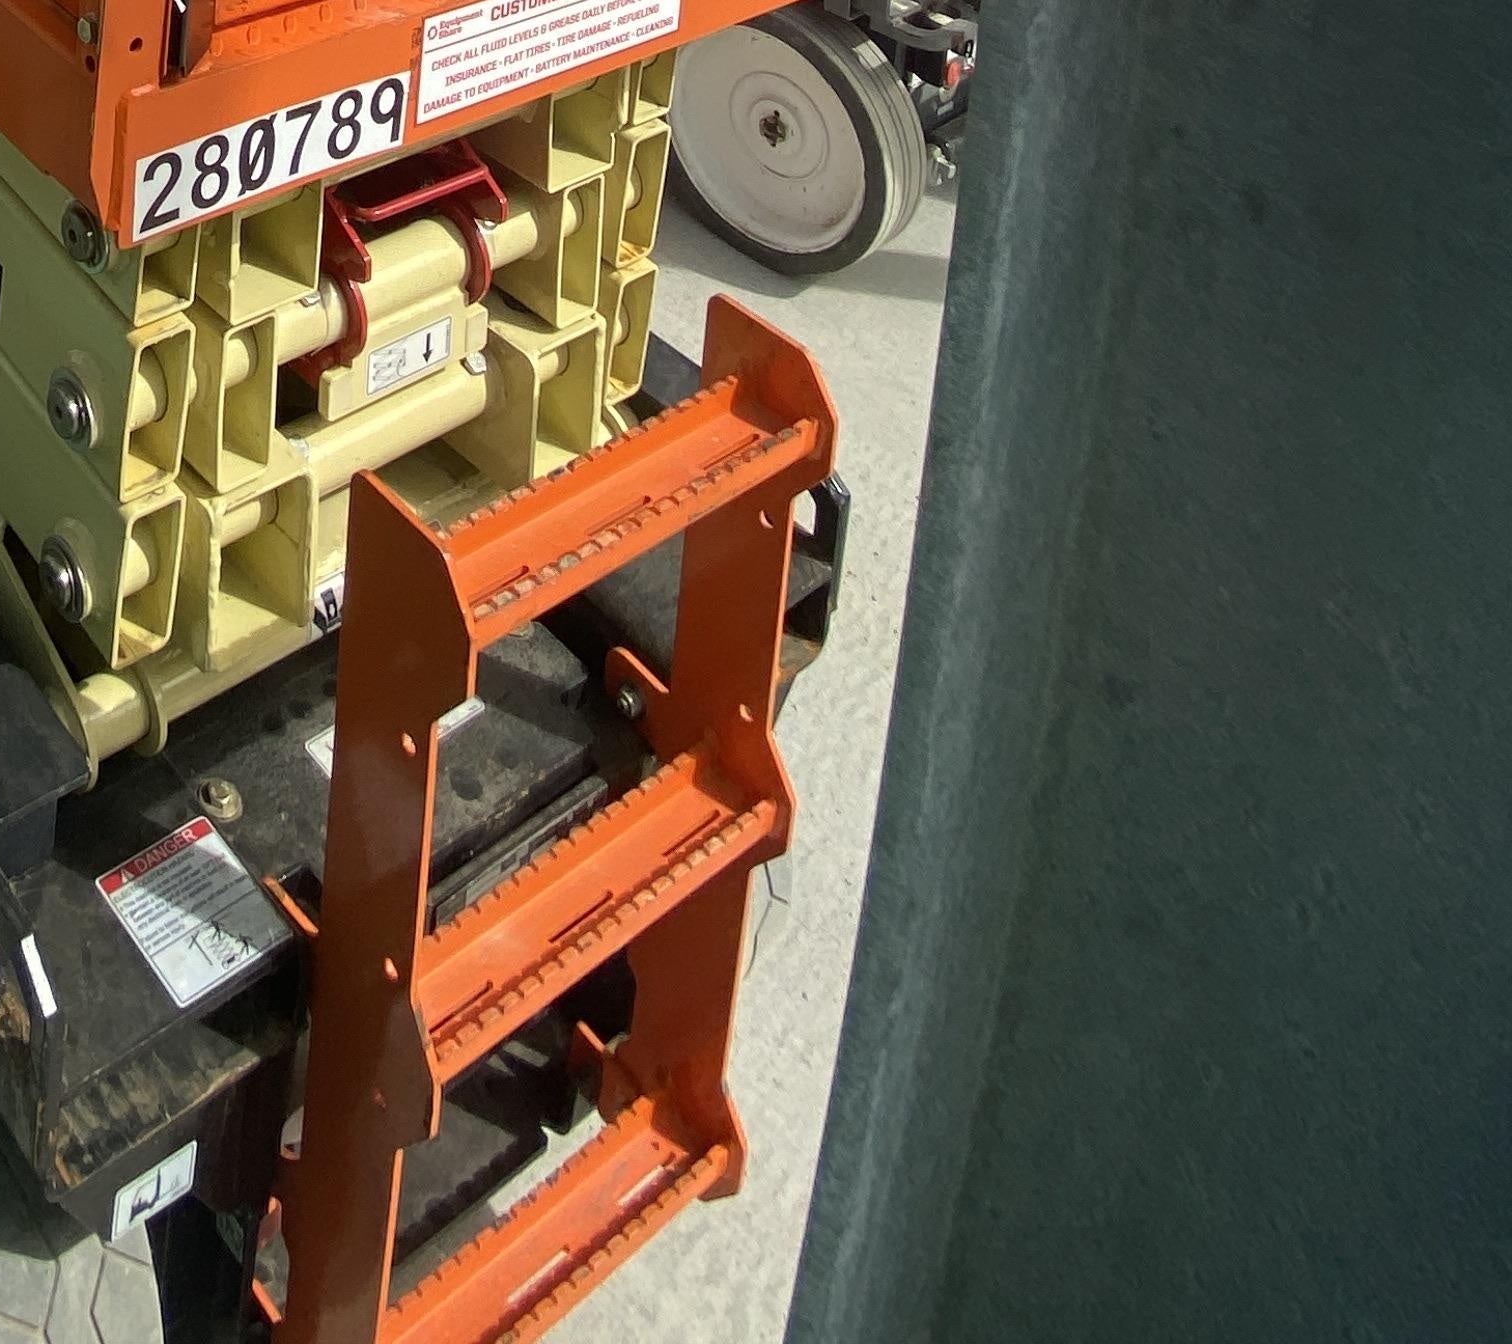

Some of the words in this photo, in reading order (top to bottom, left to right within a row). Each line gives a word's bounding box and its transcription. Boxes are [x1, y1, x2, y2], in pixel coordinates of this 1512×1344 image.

[423, 91, 462, 114] DAMAGE
[464, 86, 476, 100] TO
[478, 67, 529, 96] EQUIPMENT
[535, 53, 571, 74] BATTERY
[572, 29, 630, 62] MAINTENANCE
[636, 15, 674, 37] CLEANING
[431, 51, 462, 72] CHECK
[464, 46, 479, 62] ALL
[481, 37, 507, 57] FLUID
[509, 28, 539, 49] LEVELS
[548, 15, 580, 33] GREASE
[582, 4, 606, 22] DAILY
[445, 61, 498, 87] INSURANCE
[503, 50, 525, 68] FLAT
[526, 41, 551, 60] TIRES
[557, 33, 576, 48] TIRE
[578, 20, 611, 41] DAMAGE
[617, 3, 660, 28] REFUELING
[139, 75, 406, 235] 280789
[135, 828, 199, 874] DANGER
